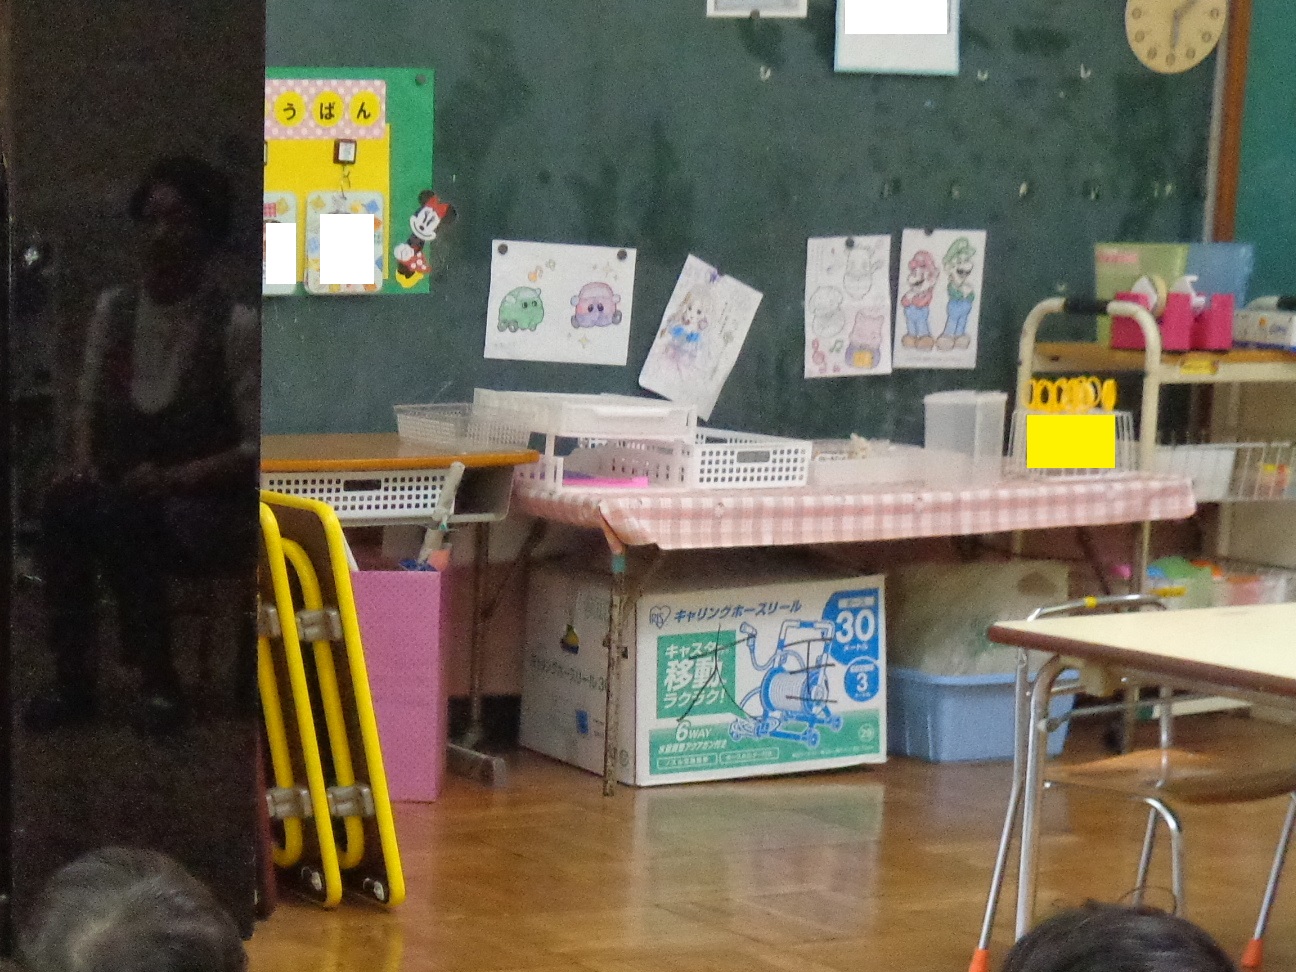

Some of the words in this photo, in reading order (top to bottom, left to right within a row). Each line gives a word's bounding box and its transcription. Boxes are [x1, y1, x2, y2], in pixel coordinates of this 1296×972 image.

[283, 101, 371, 121] うばん
[674, 600, 803, 623] キャリングホースリール
[835, 608, 876, 644] 30
[664, 655, 728, 692] 移動
[856, 672, 869, 693] 3
